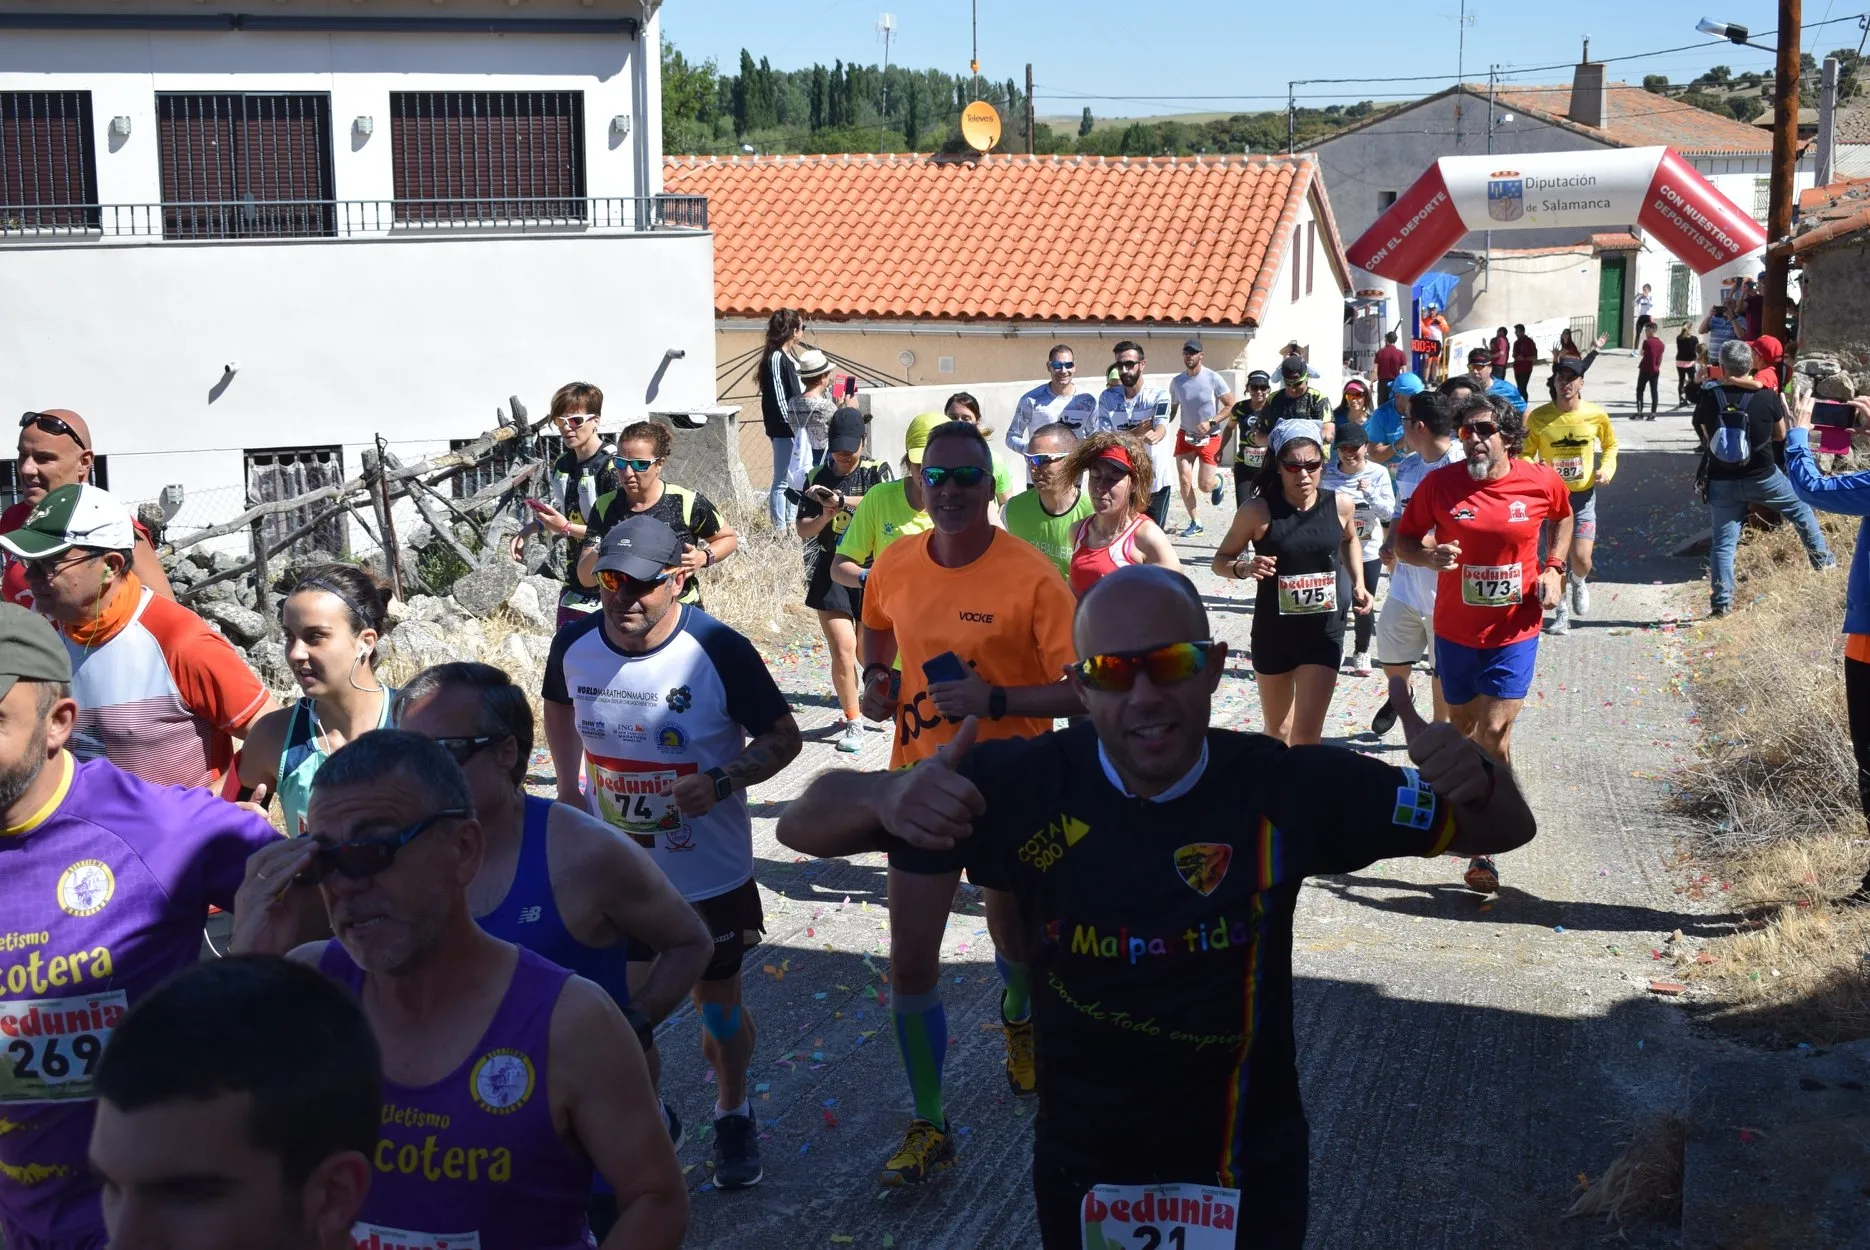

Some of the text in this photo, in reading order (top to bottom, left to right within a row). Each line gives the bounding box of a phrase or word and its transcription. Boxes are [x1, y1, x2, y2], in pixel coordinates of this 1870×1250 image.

[1525, 174, 1596, 191] Diputación
[1526, 199, 1611, 213] de Salamanca
[1660, 184, 1740, 253] CON NUESTROS
[1365, 191, 1447, 270] CON EL DEPORTE
[1654, 199, 1725, 261] DEPORTISTAS
[1556, 467, 1577, 477] 287
[1280, 576, 1335, 589] bedunia
[1464, 566, 1520, 580] bedunia
[1291, 587, 1324, 605] 175
[1475, 580, 1511, 597] 173
[959, 611, 994, 624] VOCKE
[618, 724, 633, 732] ING
[615, 793, 653, 819] 74
[1018, 821, 1061, 862] COTA
[1033, 843, 1064, 873] 900
[1071, 916, 1249, 965] Malpatida
[9, 1034, 101, 1078] 269
[1085, 1191, 1235, 1230] bedunia
[1132, 1225, 1186, 1250] 21
